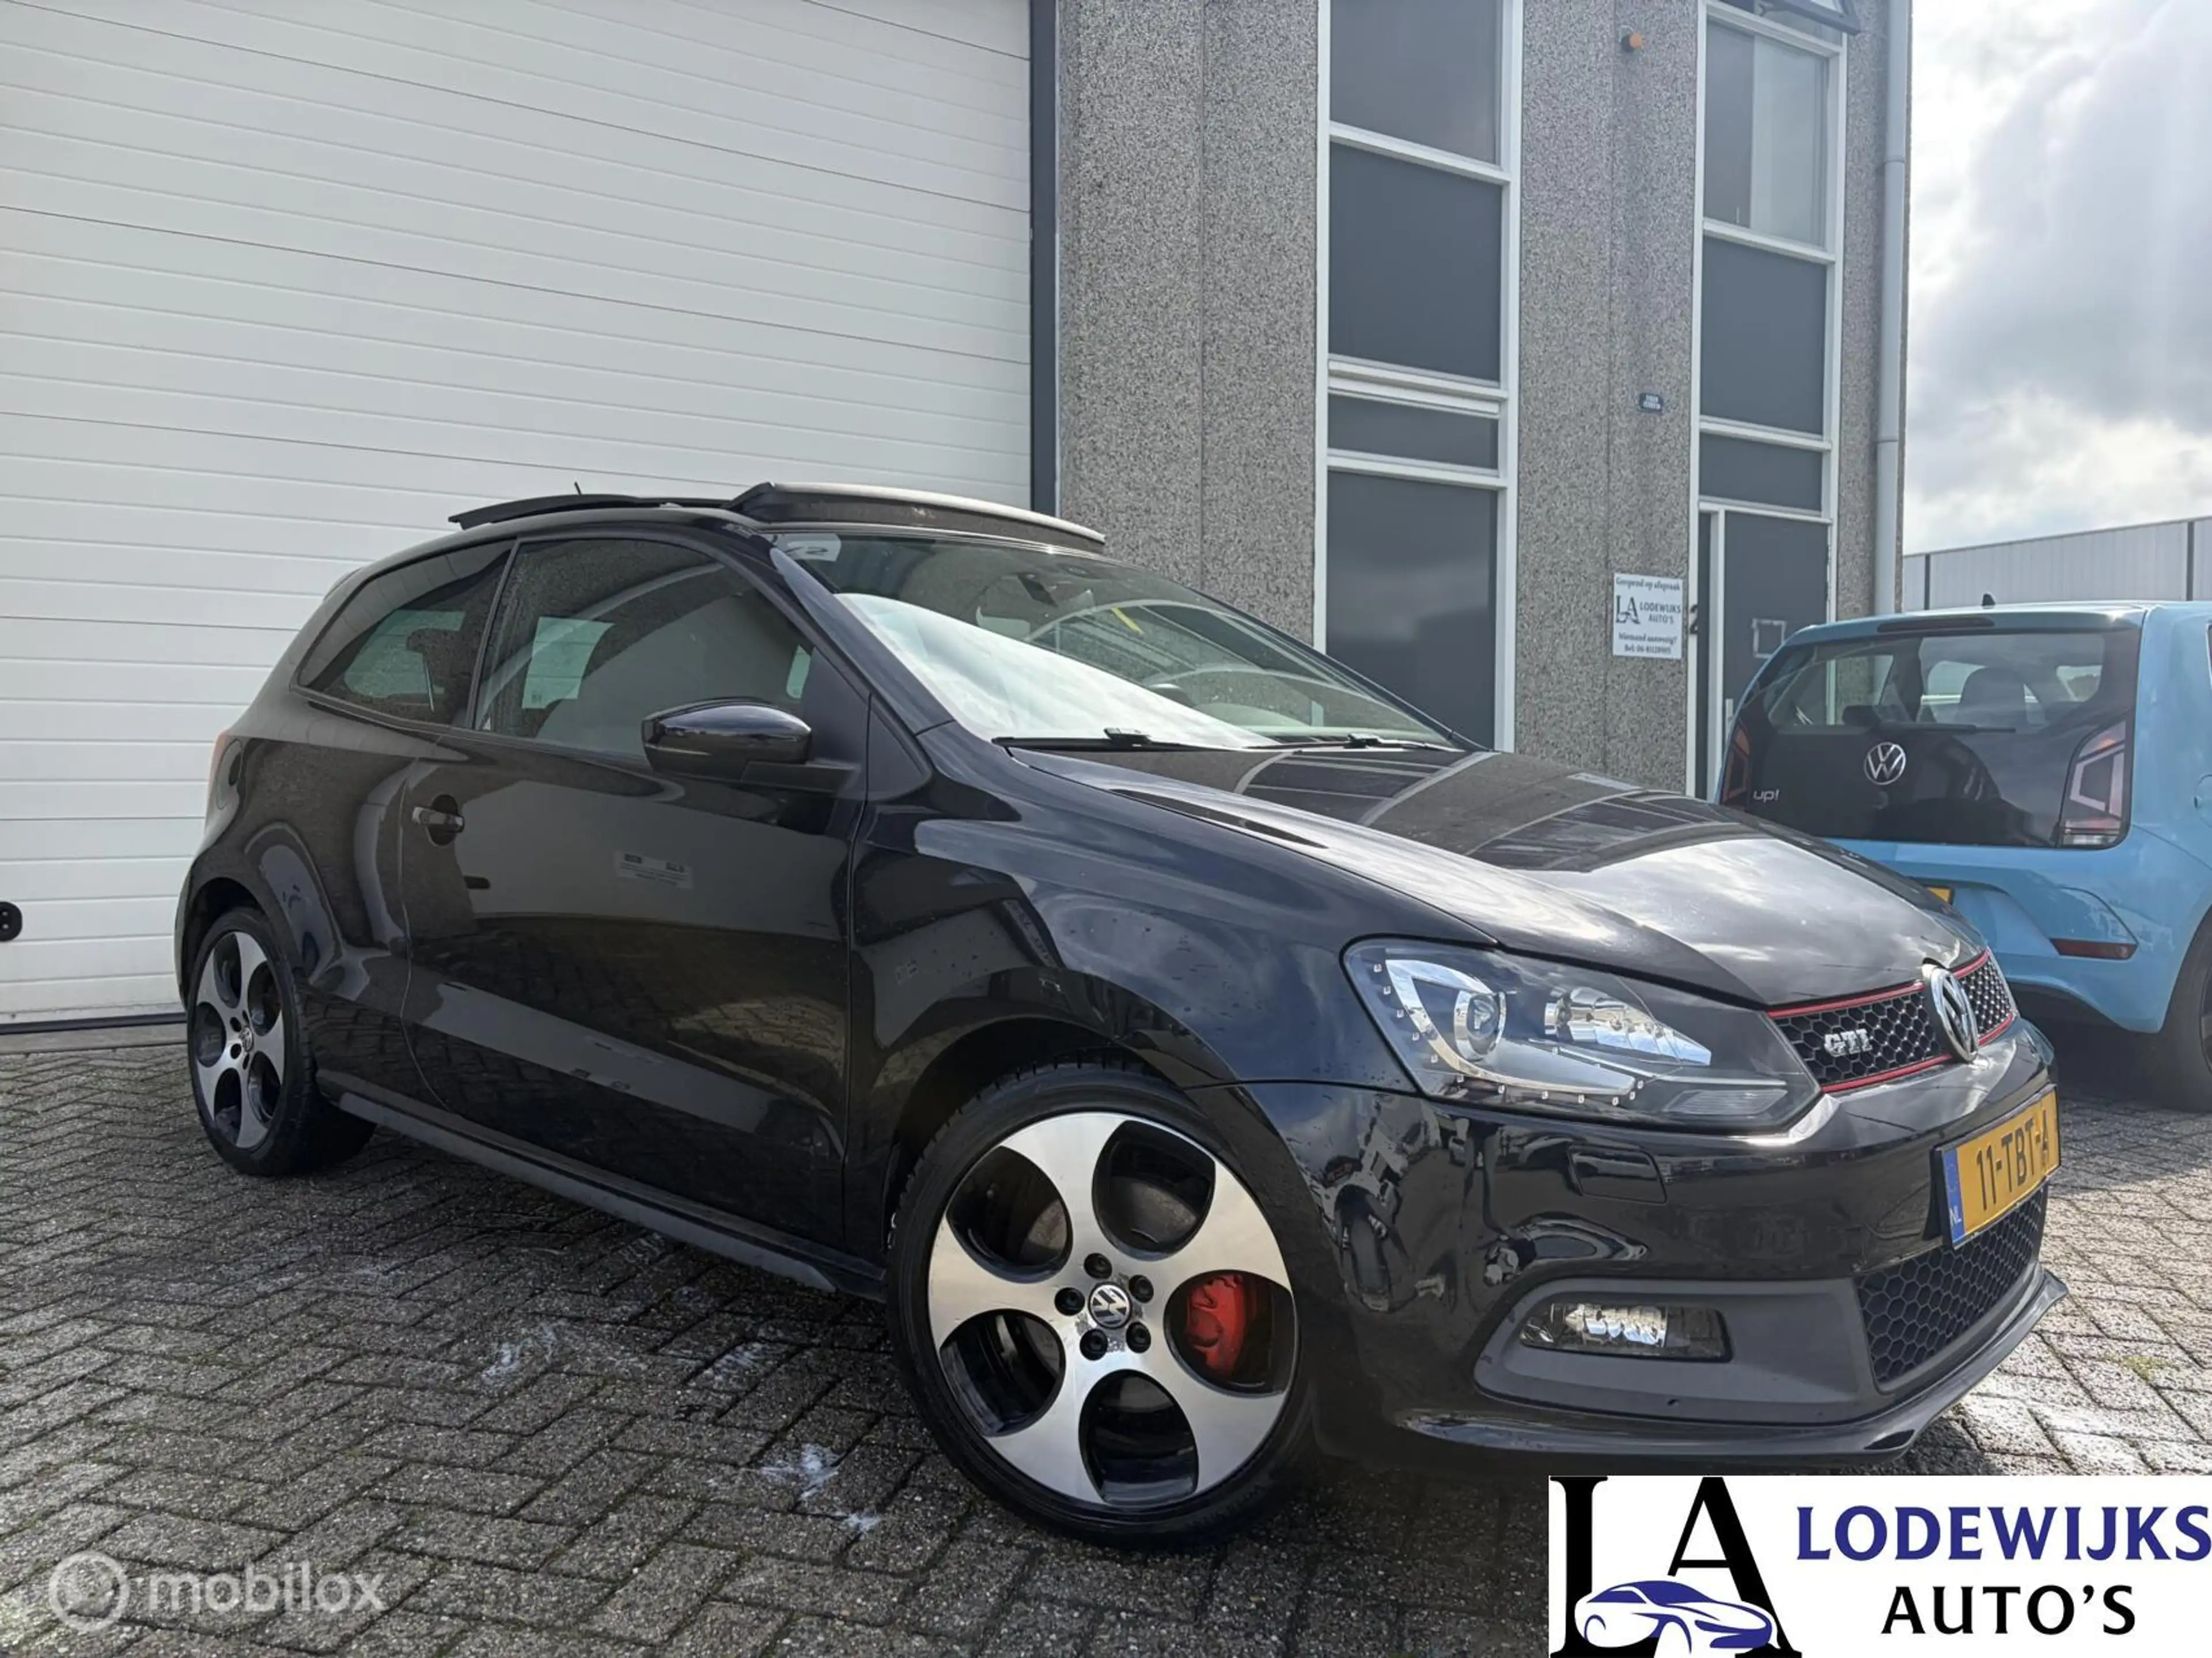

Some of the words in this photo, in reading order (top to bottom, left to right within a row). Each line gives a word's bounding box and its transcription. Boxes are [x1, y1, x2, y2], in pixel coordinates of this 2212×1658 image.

[1639, 601, 1681, 613] LODEWIJKS
[1648, 613, 1674, 624] AUTO'S
[1753, 788, 1780, 803] up!
[1824, 1028, 1873, 1057] GTI
[1949, 1205, 1962, 1227] NL
